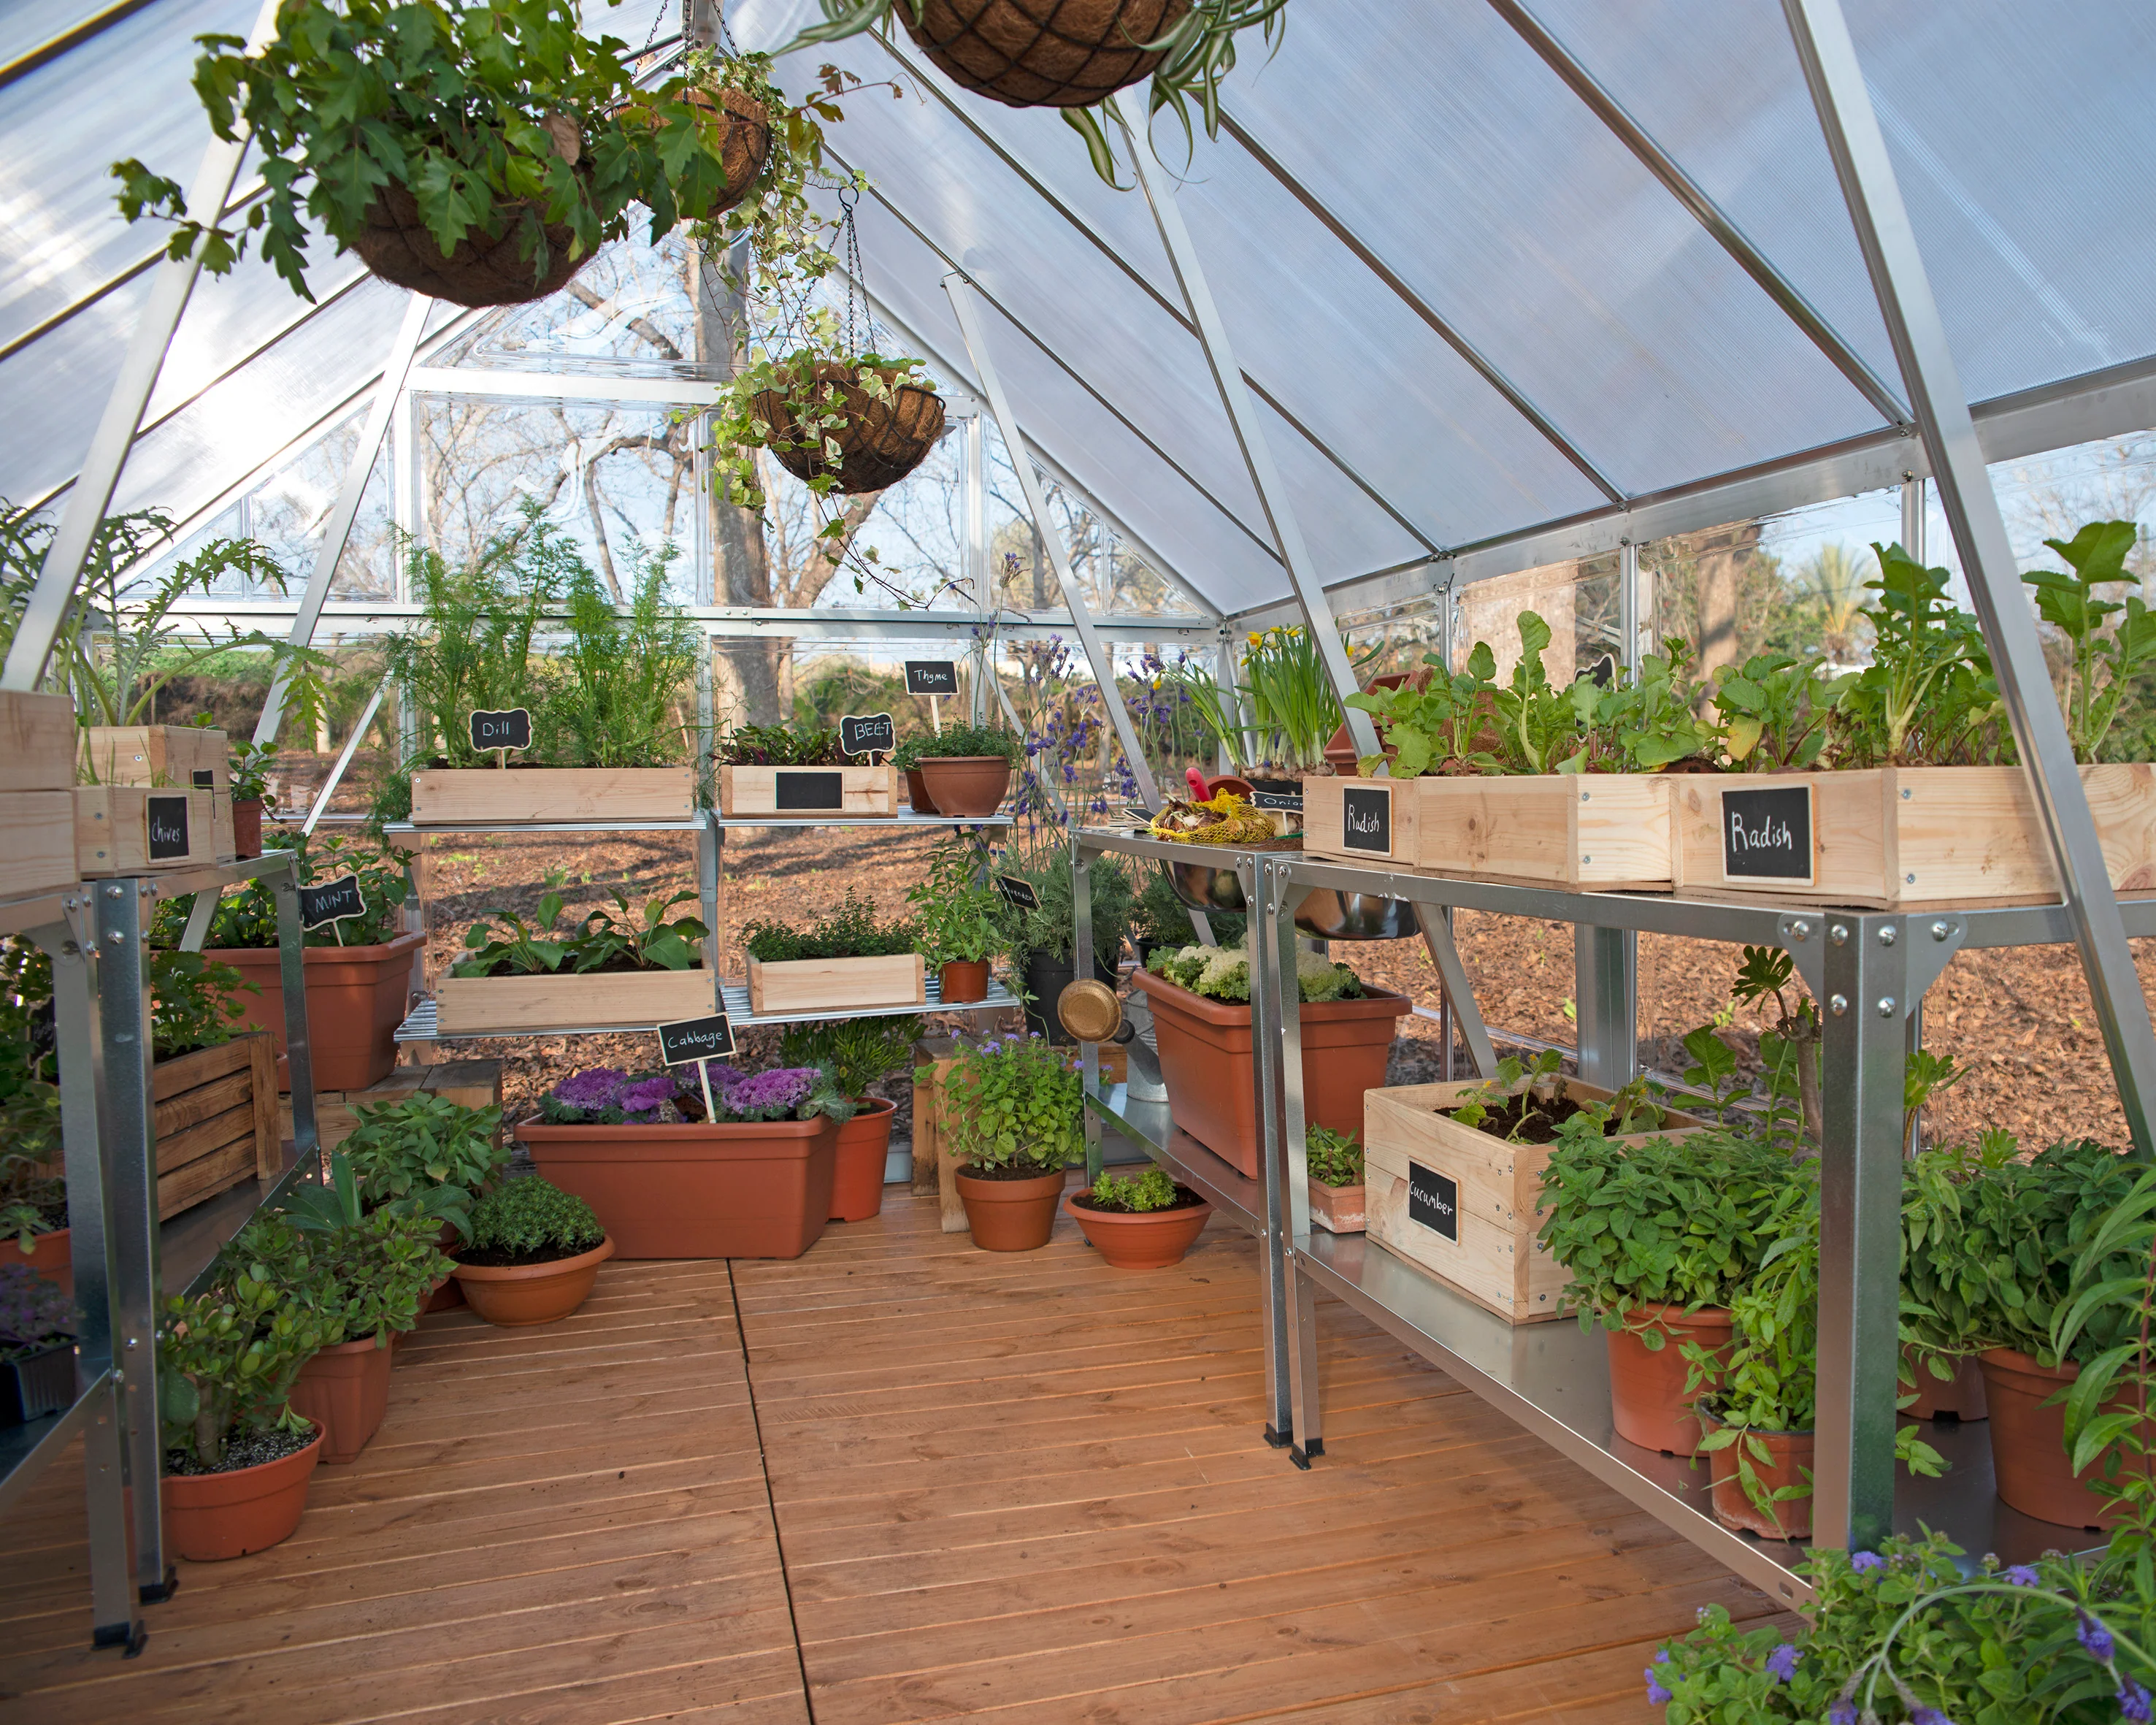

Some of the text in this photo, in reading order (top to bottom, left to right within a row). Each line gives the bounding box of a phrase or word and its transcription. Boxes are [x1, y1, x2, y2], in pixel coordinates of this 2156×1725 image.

[913, 669, 948, 684] Thyme
[483, 720, 509, 736] Dill
[854, 722, 891, 741] BEET
[1348, 803, 1380, 833] Radish
[1731, 811, 1792, 853] Radish
[999, 882, 1032, 900] Lvender
[315, 890, 352, 914] MINT
[667, 1030, 723, 1049] Cabbage
[1409, 1181, 1453, 1216] Cucumber
